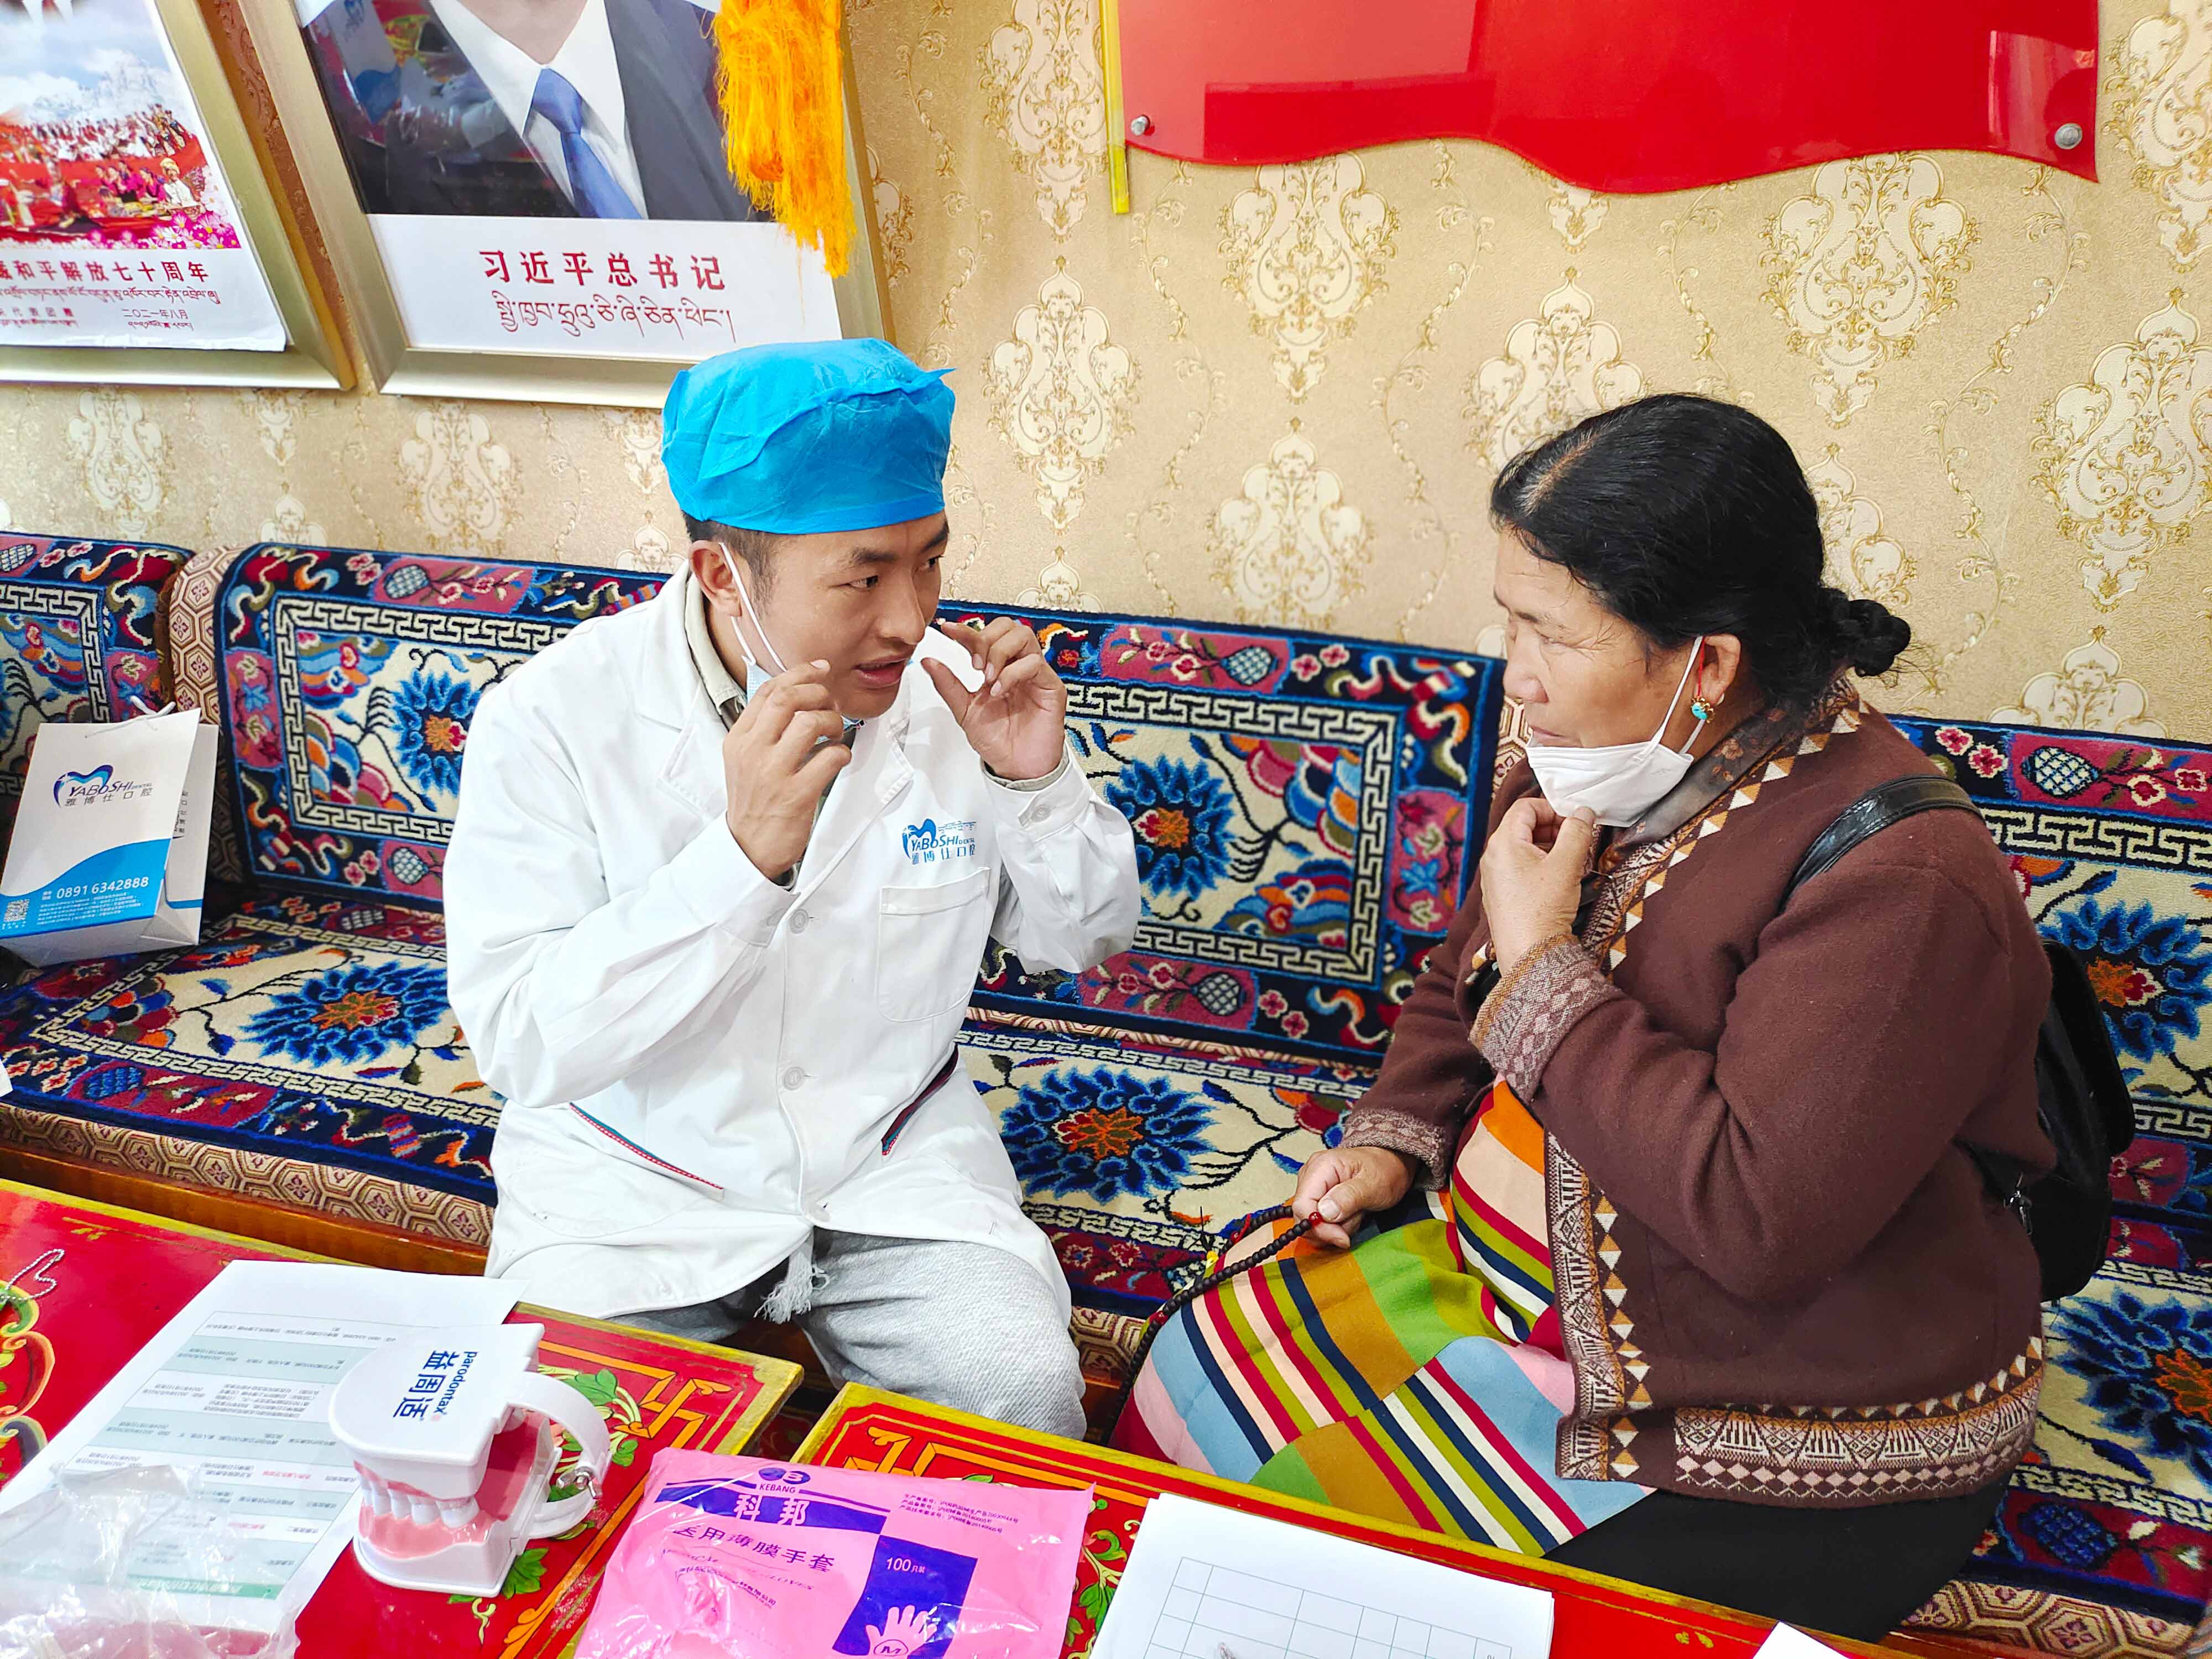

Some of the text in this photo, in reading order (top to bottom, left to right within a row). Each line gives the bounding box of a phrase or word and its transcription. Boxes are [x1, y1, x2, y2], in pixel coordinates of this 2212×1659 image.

[479, 250, 726, 290] 习近平总书记
[64, 787, 153, 807] 雅博仕口腔
[56, 885, 88, 899] 0891
[91, 877, 149, 894] 6342888
[393, 1350, 461, 1418] 益周适
[434, 1351, 478, 1413] parodontax
[759, 1483, 796, 1494] KEBANG
[733, 1493, 811, 1526] 科邦
[672, 1525, 835, 1573] 医用薄膜手套
